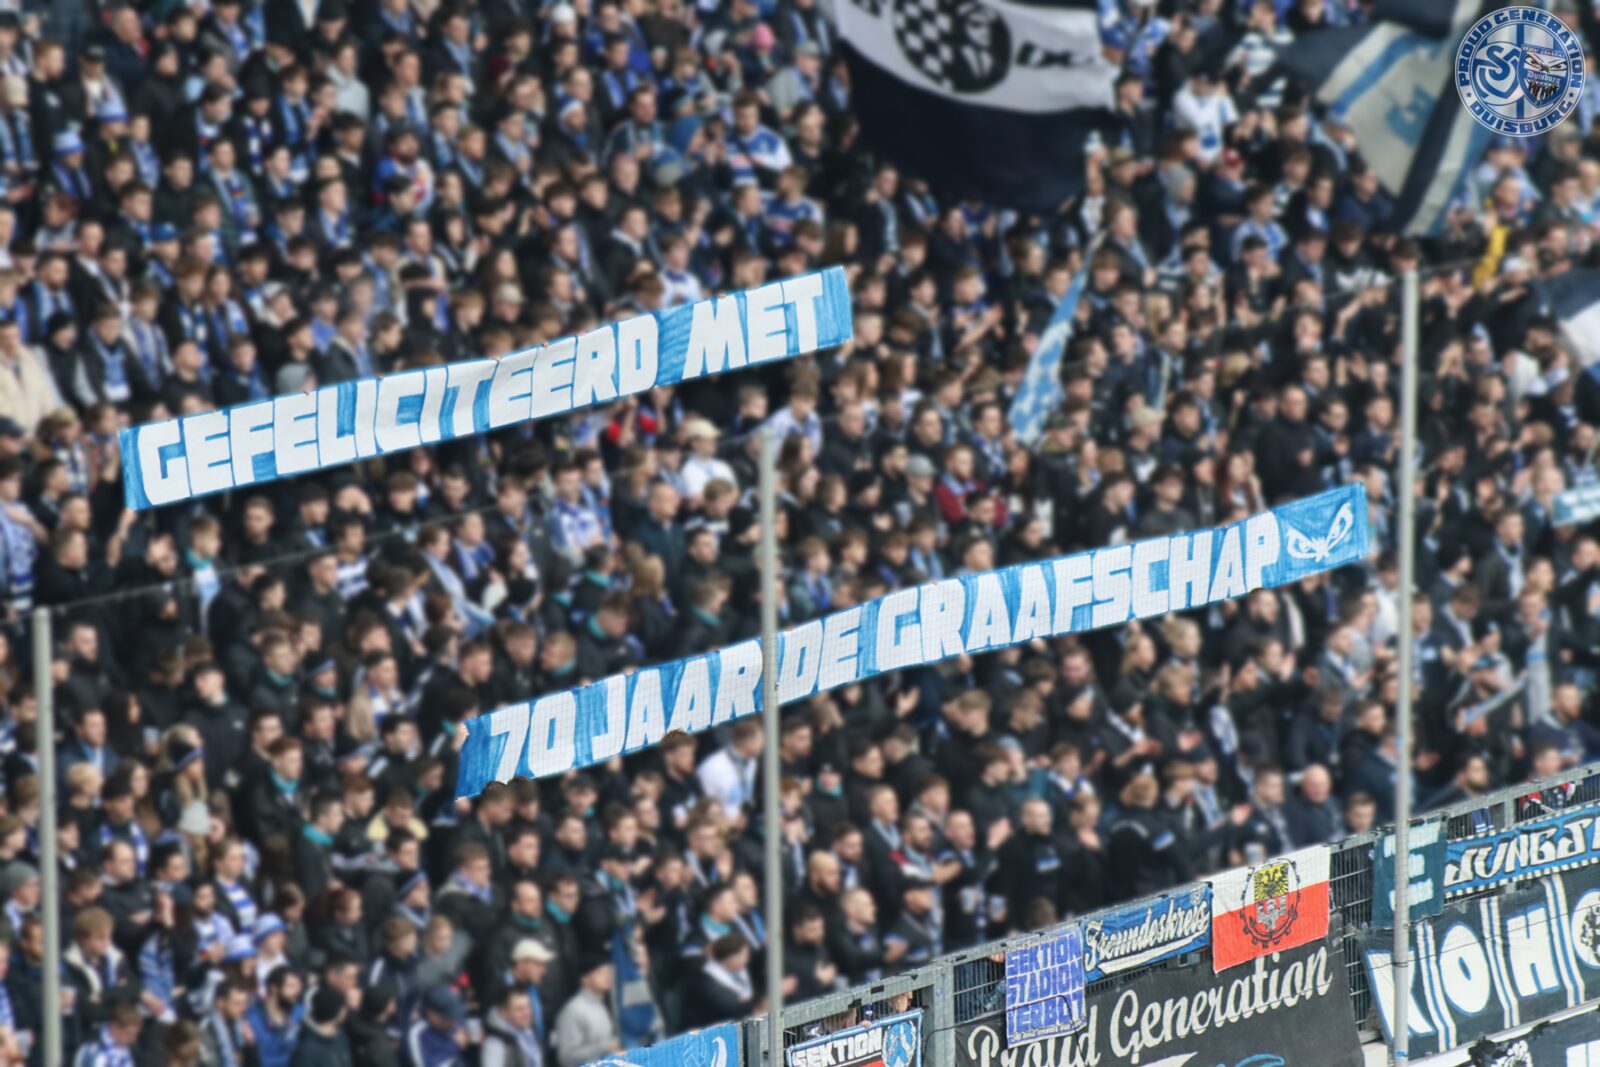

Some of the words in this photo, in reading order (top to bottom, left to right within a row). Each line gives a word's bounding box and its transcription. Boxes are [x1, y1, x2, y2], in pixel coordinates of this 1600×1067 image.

[138, 314, 659, 506] GEFELICITEERD
[682, 272, 824, 381] MET
[490, 692, 576, 785] 70
[592, 640, 764, 761] JAAR
[776, 606, 862, 707] DE
[876, 512, 1280, 672] GRAAFSCHAP
[1007, 931, 1082, 978] SEKTION
[1007, 962, 1084, 1008] STADION
[1110, 946, 1333, 1064] Generation
[792, 1028, 882, 1067] SEKTION
